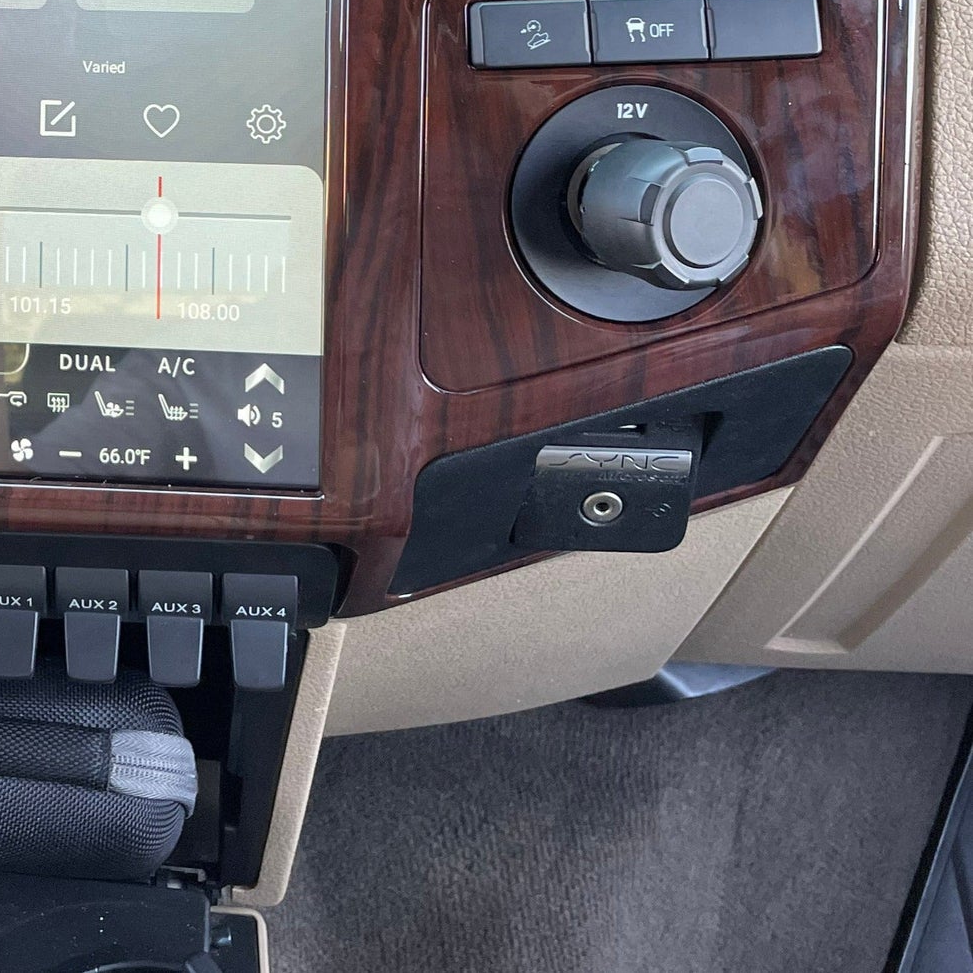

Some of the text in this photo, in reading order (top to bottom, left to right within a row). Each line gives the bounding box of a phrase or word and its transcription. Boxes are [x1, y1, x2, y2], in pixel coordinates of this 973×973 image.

[649, 23, 674, 38] OFF
[82, 60, 126, 75] Varied
[617, 103, 648, 119] 12V
[9, 296, 72, 315] 101.15
[177, 302, 241, 322] 108.00
[58, 353, 117, 373] DUAL
[158, 357, 197, 377] A/C
[271, 413, 283, 429] 5
[98, 446, 151, 466] 66.0°F
[549, 452, 680, 472] SYNC
[28, 595, 34, 607] 1
[68, 598, 118, 611] AUX 2
[151, 602, 201, 615] AUX 3
[235, 605, 287, 618] AUX 4
